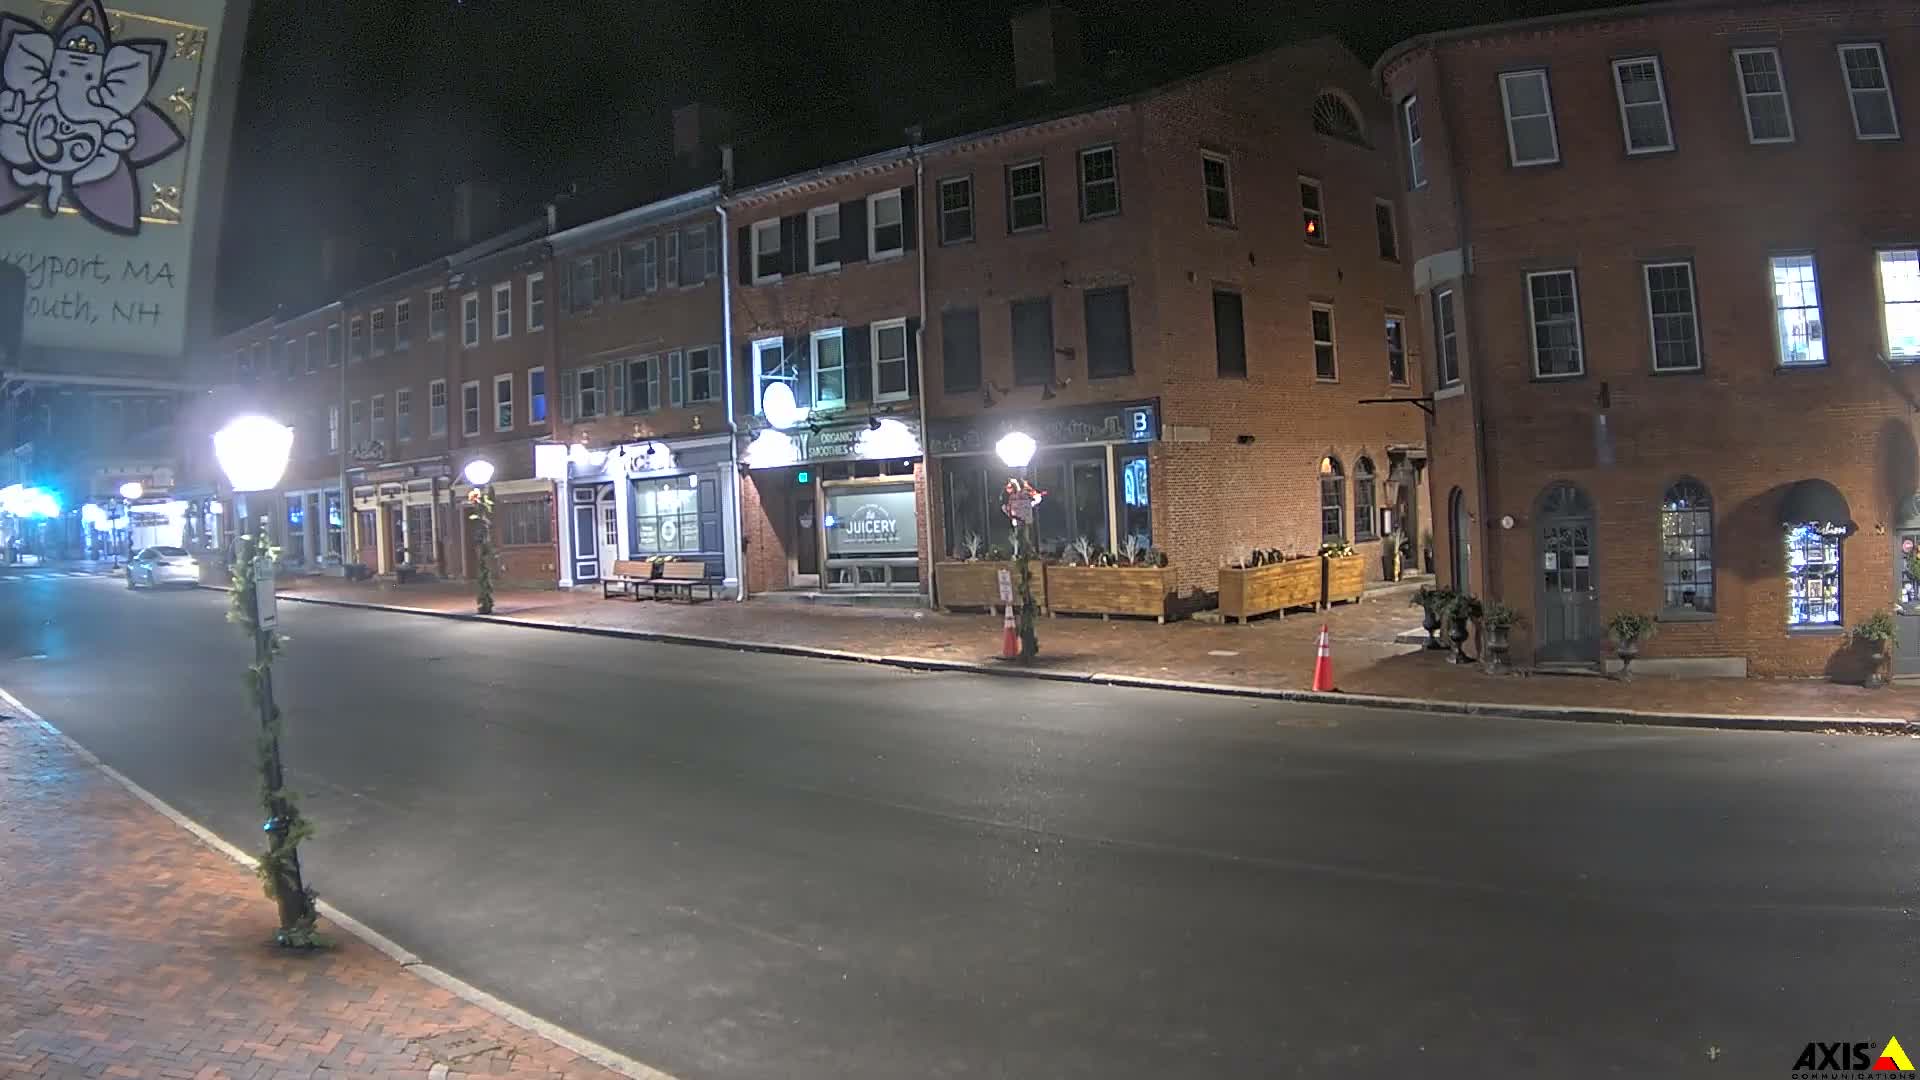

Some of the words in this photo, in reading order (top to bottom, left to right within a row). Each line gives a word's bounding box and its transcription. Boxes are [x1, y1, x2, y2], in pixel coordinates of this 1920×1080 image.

[123, 259, 175, 288] MA
[111, 300, 160, 329] NH
[1133, 411, 1147, 431] B
[821, 431, 853, 444] ORGANIC
[808, 444, 849, 458] SMOOTHIES
[846, 519, 897, 534] JUICERY
